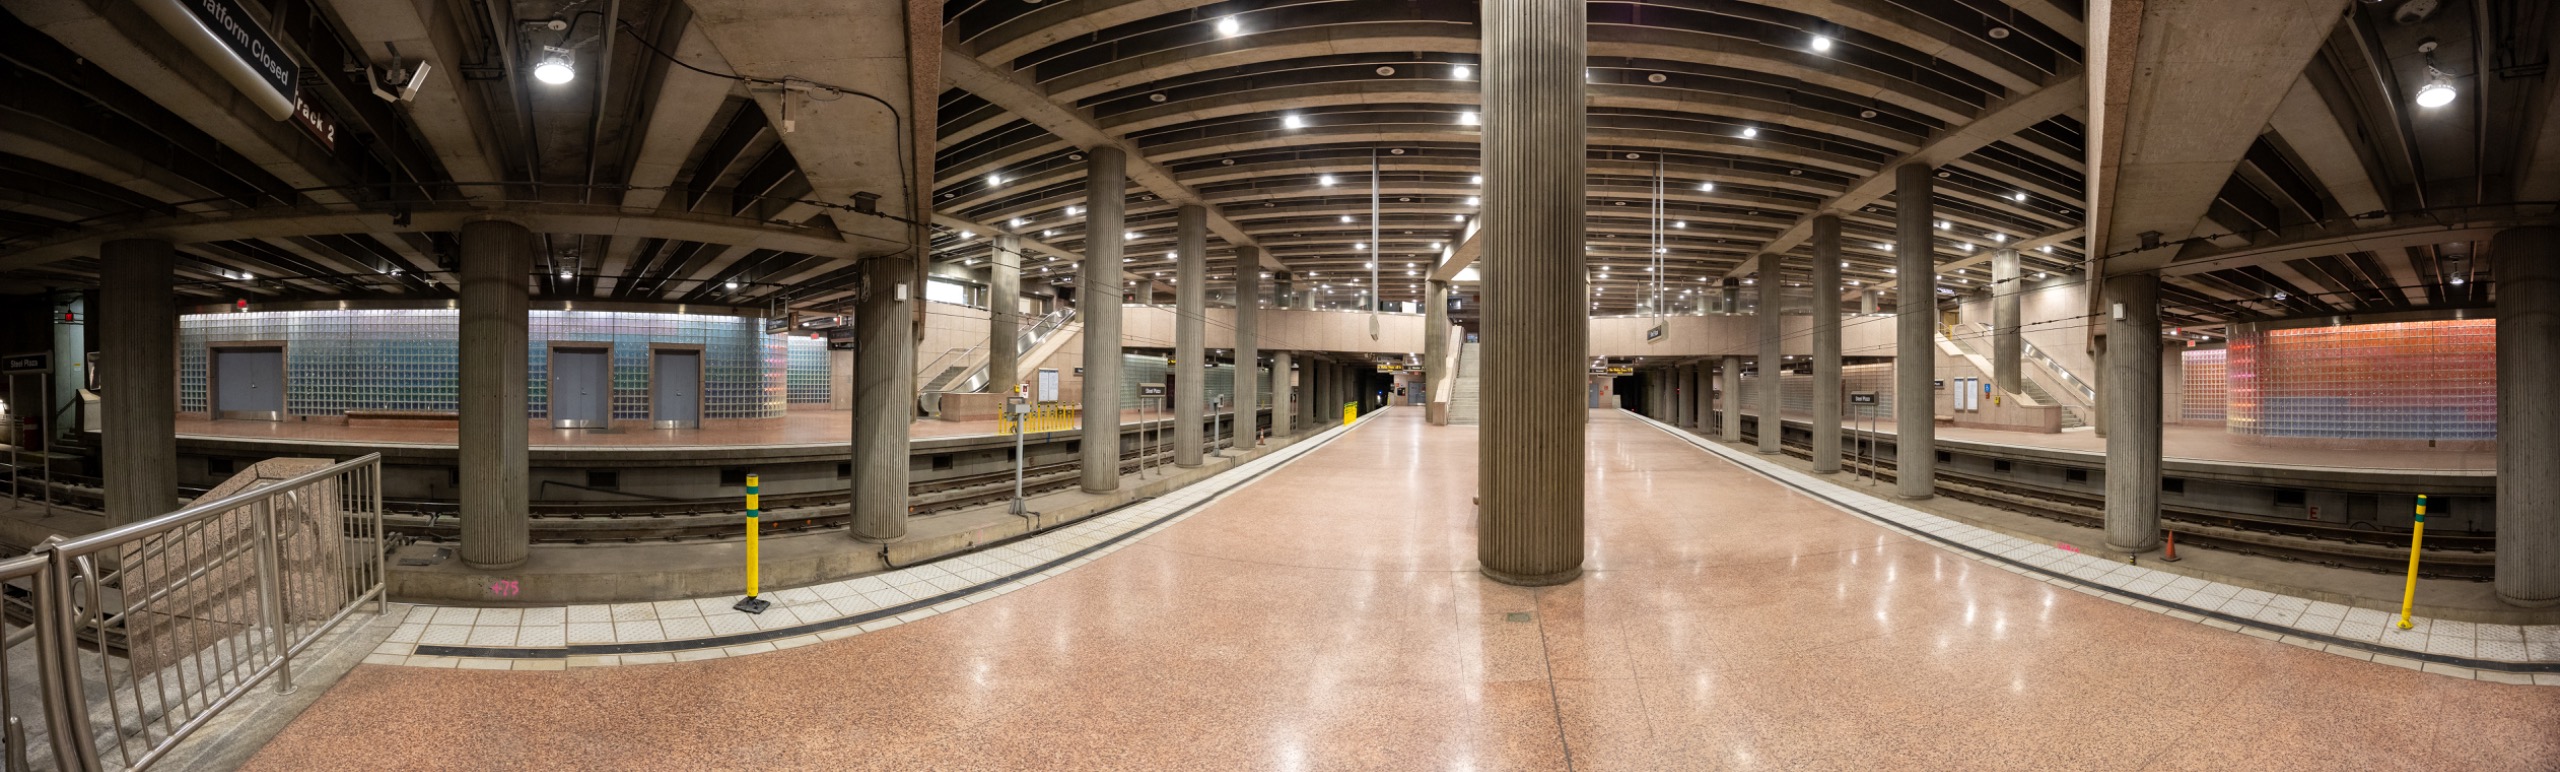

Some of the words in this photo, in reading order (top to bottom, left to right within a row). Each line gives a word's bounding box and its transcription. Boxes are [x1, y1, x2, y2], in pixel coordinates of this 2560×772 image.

[251, 39, 288, 86] Closed
[327, 124, 335, 142] 2
[2310, 506, 2319, 520] E
